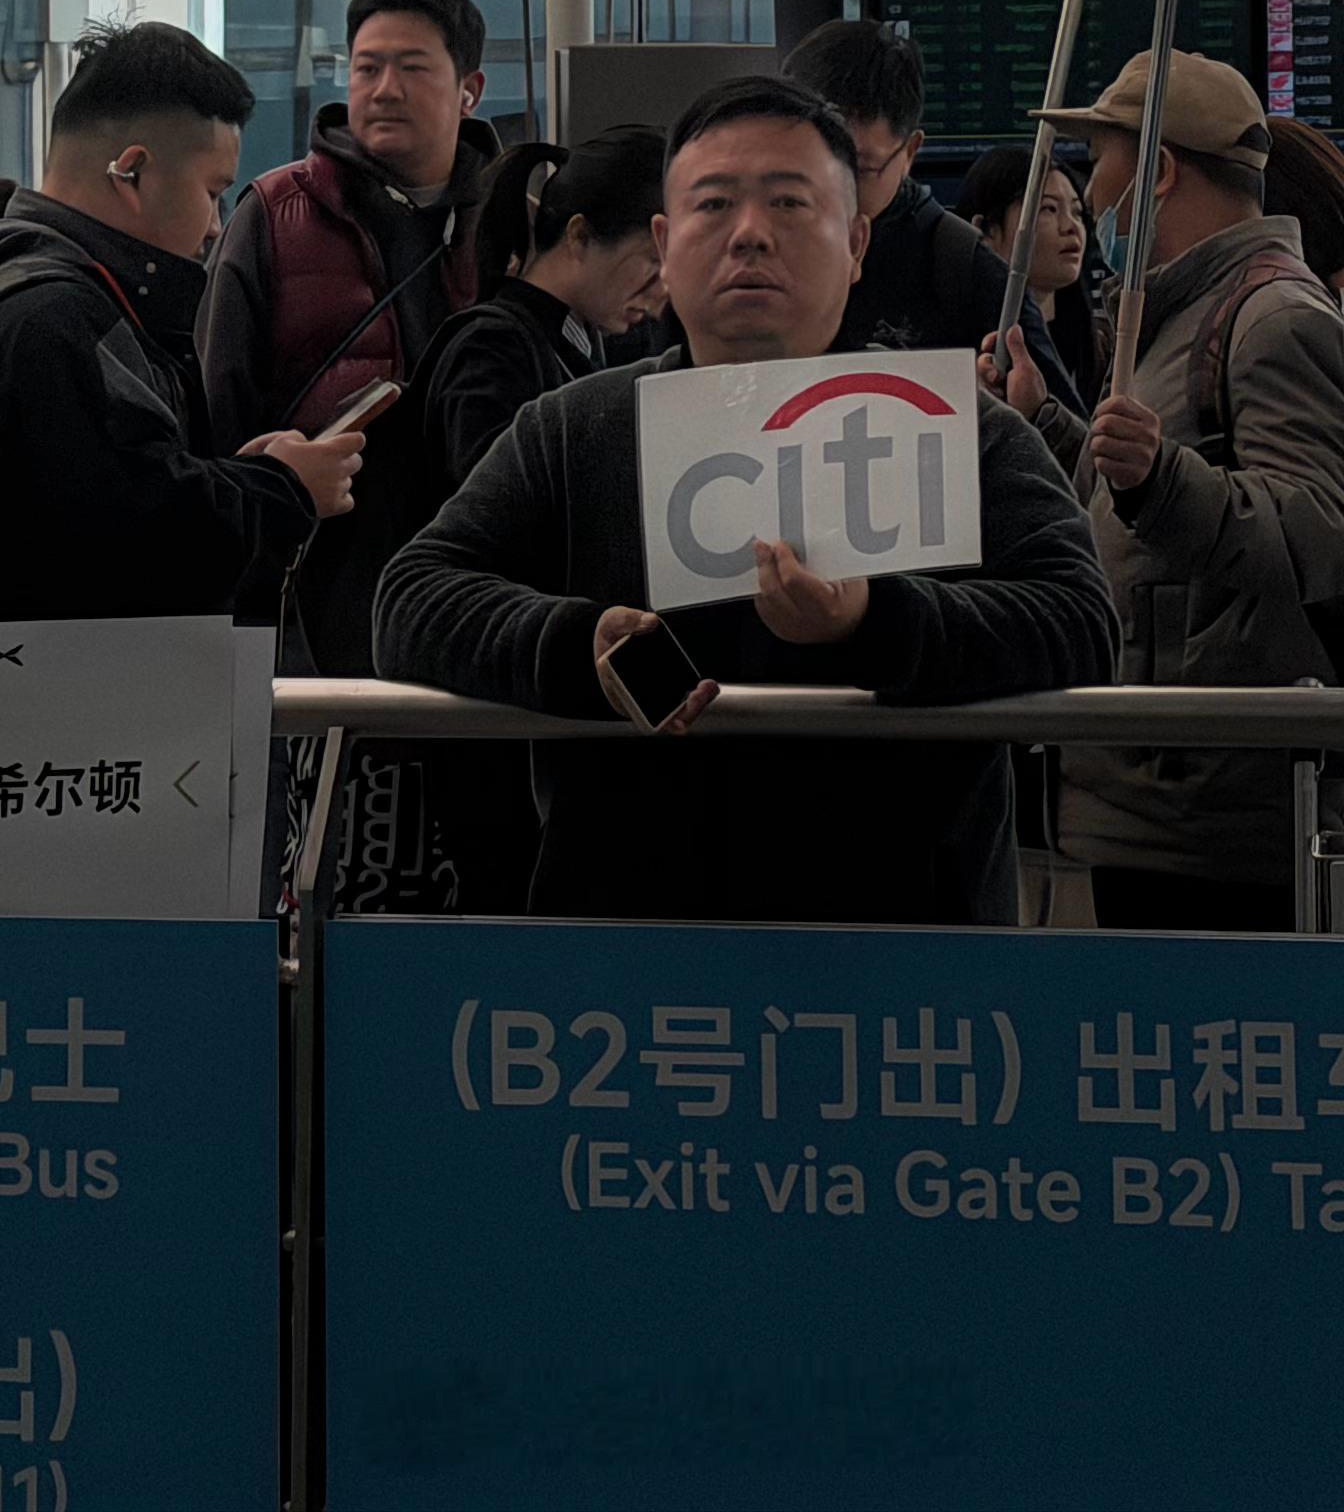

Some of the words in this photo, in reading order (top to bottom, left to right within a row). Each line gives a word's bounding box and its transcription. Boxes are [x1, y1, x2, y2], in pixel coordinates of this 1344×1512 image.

[667, 405, 946, 580] citi
[451, 999, 1021, 1126] (B2号门出)
[561, 1133, 731, 1212] (Exit
[754, 1145, 865, 1216] via
[895, 1149, 1081, 1223] Gate
[1112, 1152, 1241, 1232] B2)
